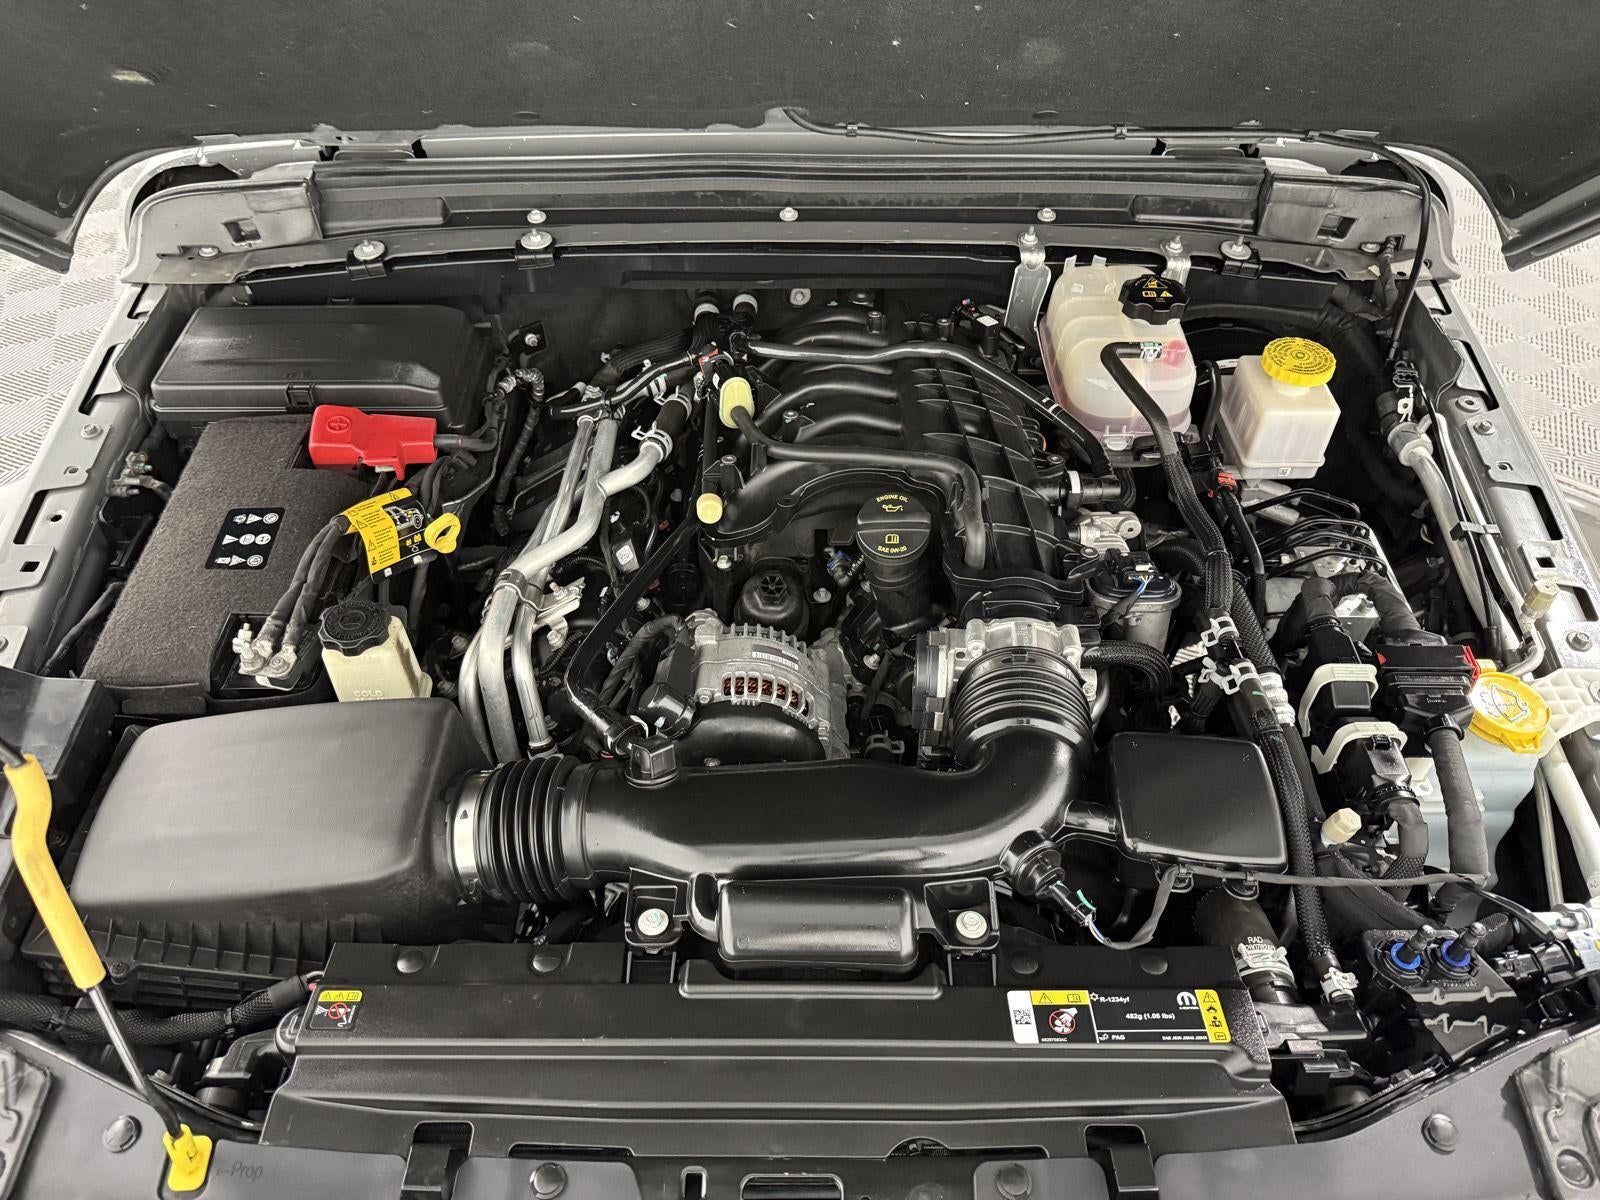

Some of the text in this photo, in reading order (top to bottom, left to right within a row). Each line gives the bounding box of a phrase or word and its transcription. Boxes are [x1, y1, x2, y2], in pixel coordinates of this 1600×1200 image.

[876, 494, 909, 503] ENGINE OIL
[878, 545, 907, 554] SAE 0W-20
[1099, 996, 1130, 1004] R-1234yf
[1161, 1013, 1176, 1021] lbs)
